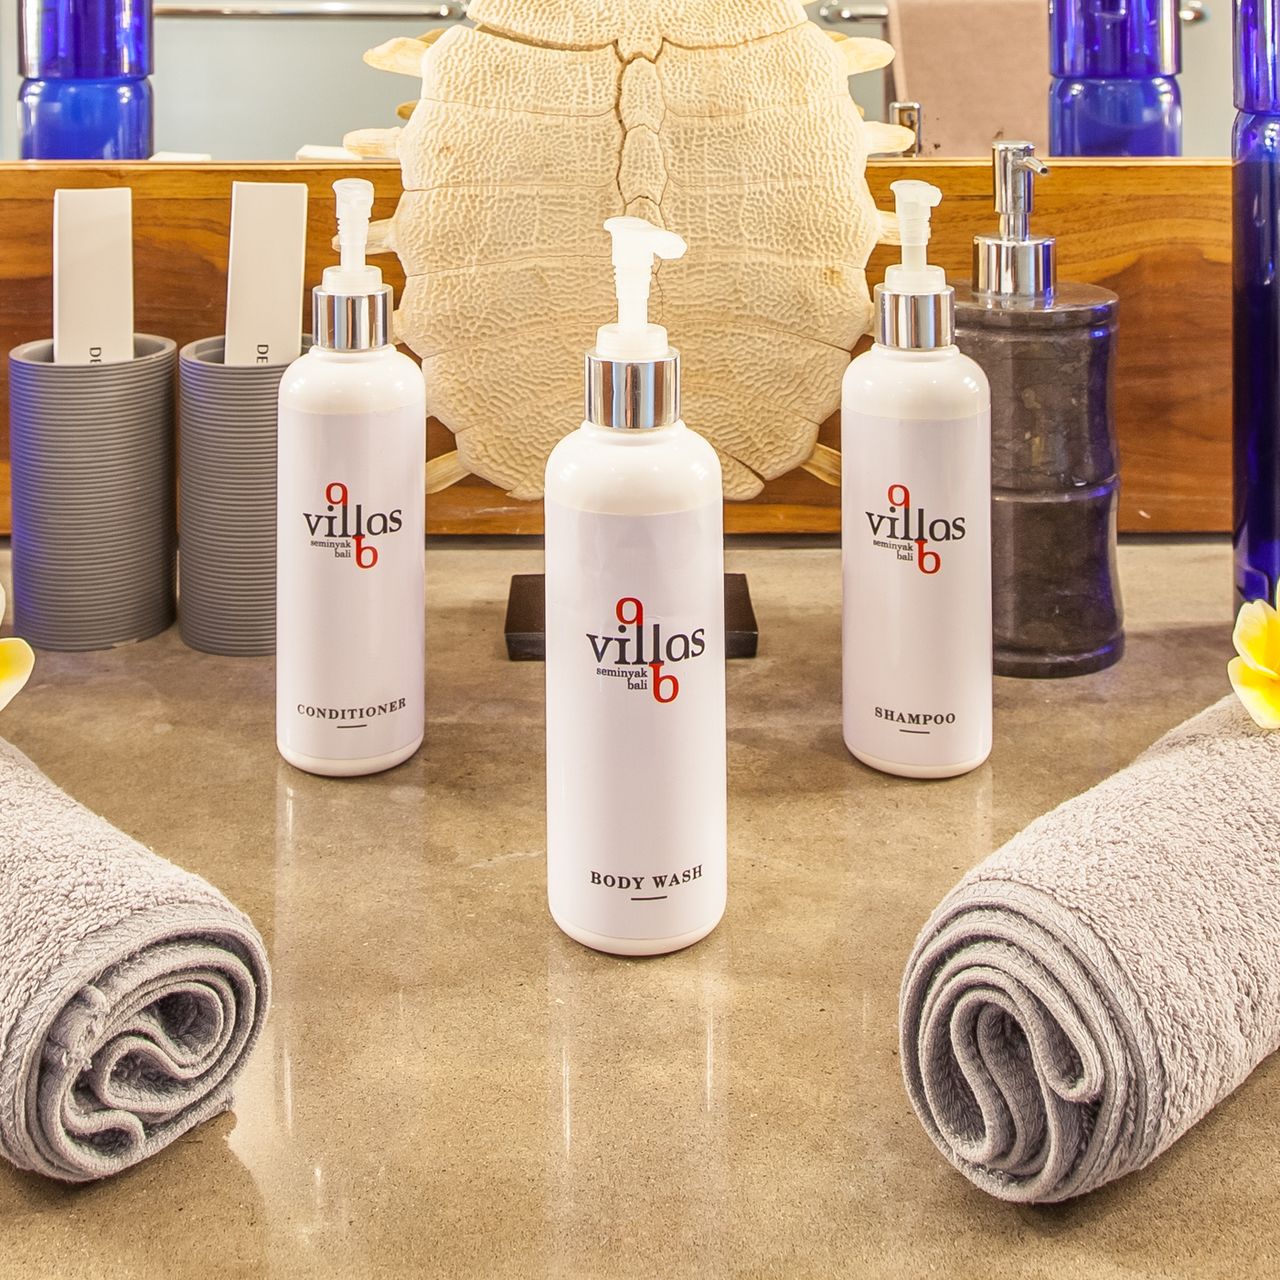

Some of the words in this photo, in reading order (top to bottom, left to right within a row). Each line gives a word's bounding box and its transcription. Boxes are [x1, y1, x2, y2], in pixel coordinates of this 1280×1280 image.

[302, 504, 403, 538] villas
[865, 506, 966, 542] villas
[310, 539, 351, 552] seminyak
[334, 548, 352, 558] bali
[872, 538, 914, 552] seminyak
[896, 550, 914, 561] bali
[585, 623, 706, 665] villas
[596, 667, 648, 680] seminyak
[627, 677, 648, 690] bali
[296, 697, 407, 720] CONDITIONER
[874, 705, 957, 726] SHAMPOO
[590, 870, 645, 890] BODY
[651, 864, 704, 889] WASH
